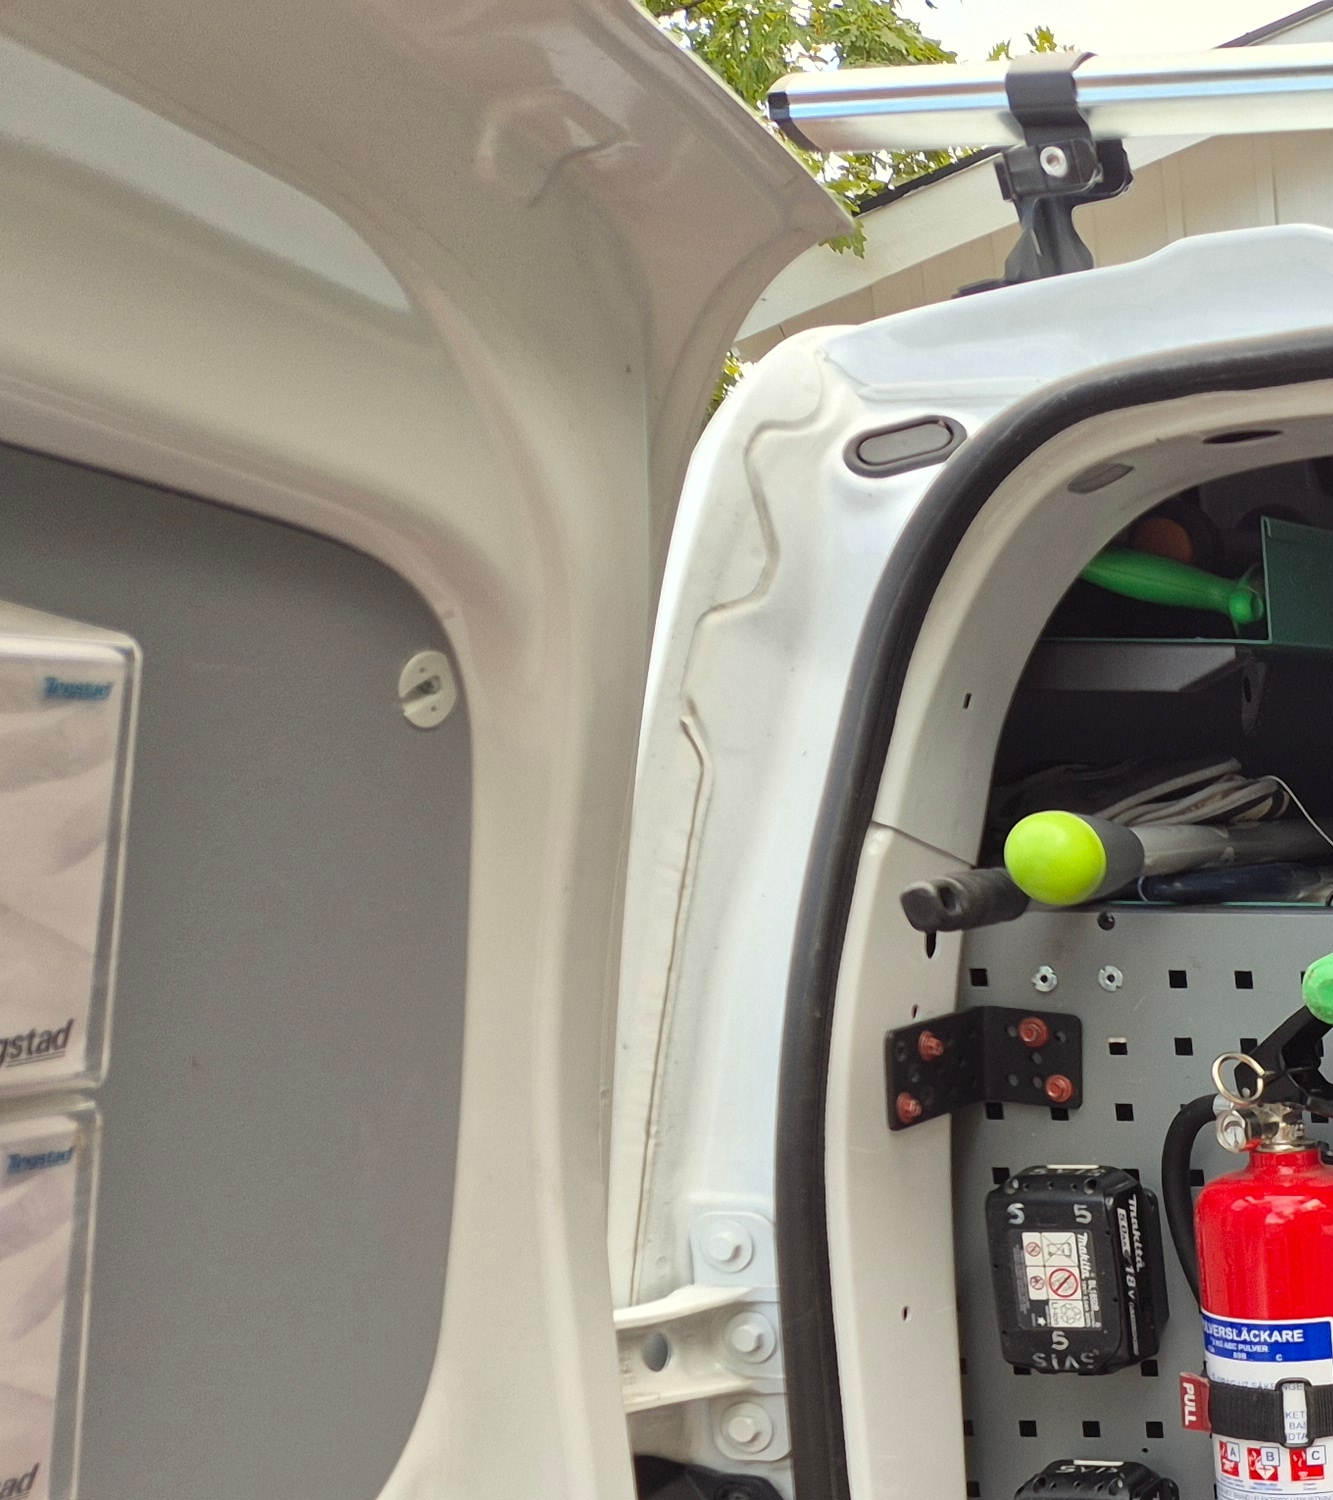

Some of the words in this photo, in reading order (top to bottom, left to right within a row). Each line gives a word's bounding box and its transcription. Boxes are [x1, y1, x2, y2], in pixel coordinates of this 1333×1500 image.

[1128, 1194, 1145, 1273] makita
[1077, 1232, 1091, 1279] makita
[1182, 1381, 1197, 1426] PULL
[1229, 1447, 1237, 1457] A
[1265, 1451, 1275, 1462] B
[1311, 1450, 1321, 1461] C
